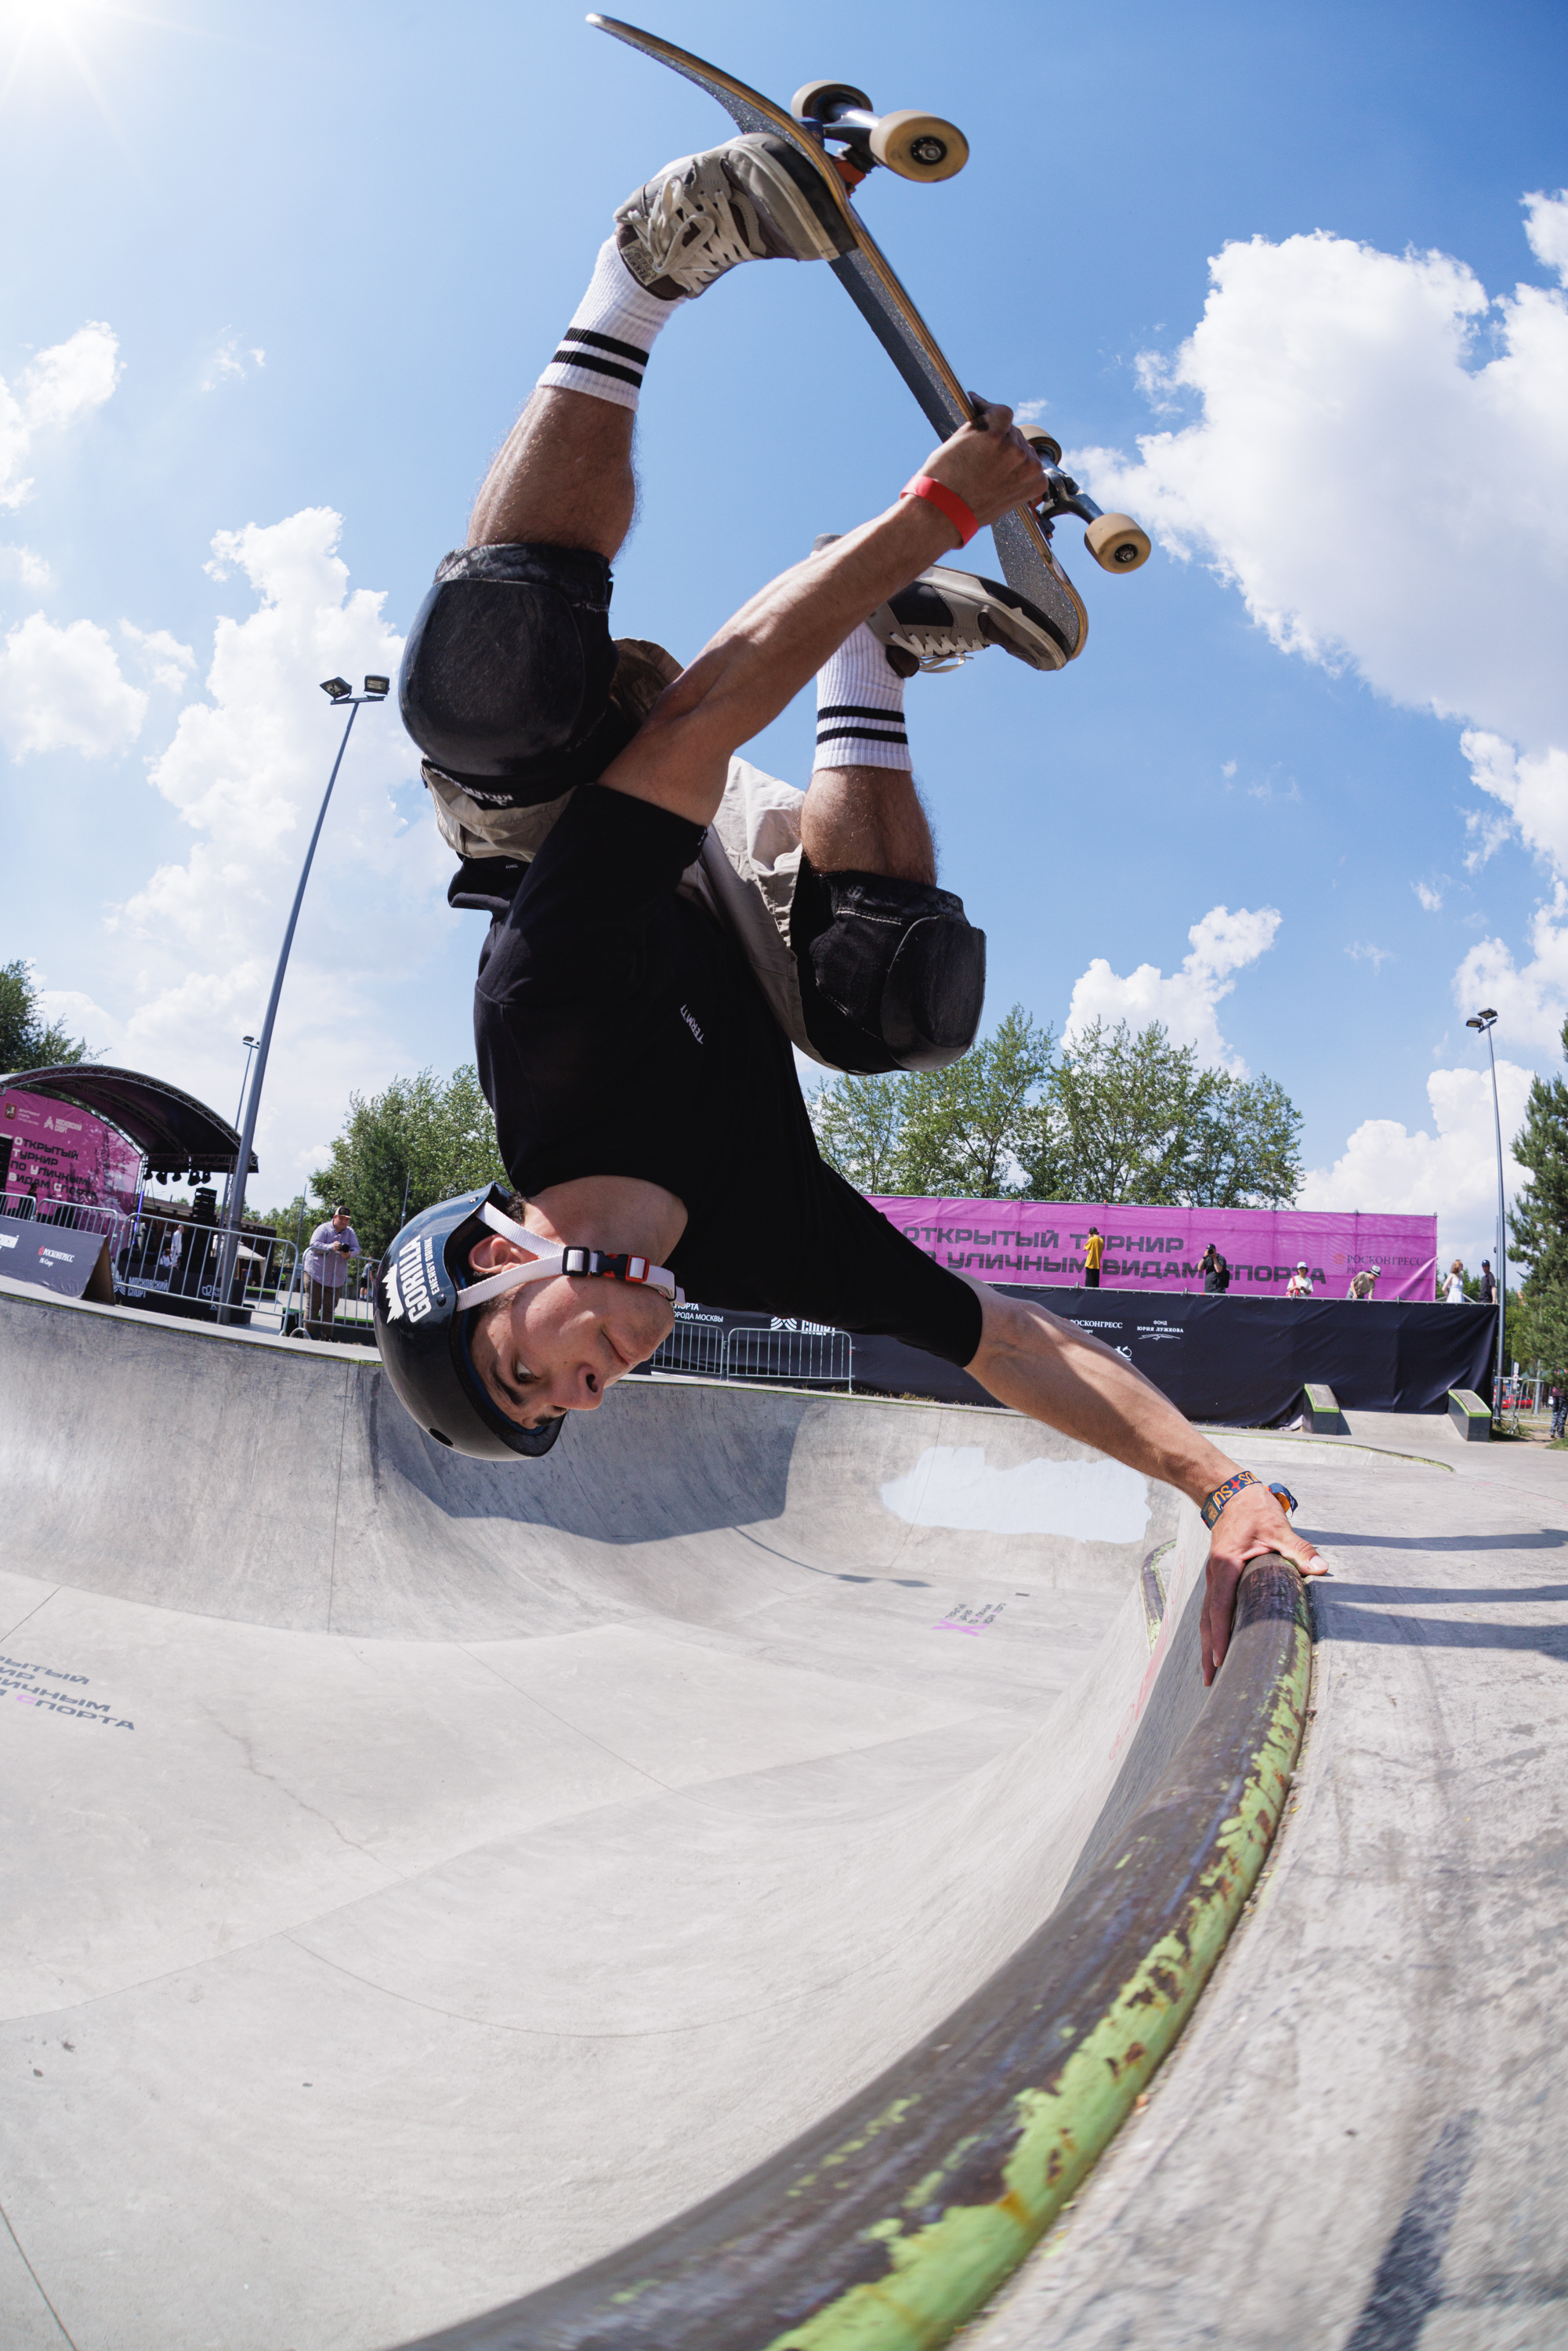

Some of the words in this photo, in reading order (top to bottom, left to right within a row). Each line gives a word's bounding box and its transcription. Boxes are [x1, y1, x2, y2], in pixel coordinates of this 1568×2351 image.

[13, 1148, 58, 1166] ТУРНИР
[14, 1136, 79, 1160] ОТКРЫТЫЙ
[8, 1172, 50, 1189] ВИДАМ
[10, 1161, 27, 1171] ПО
[30, 1165, 88, 1186] УЛИЧНЫМ
[424, 1237, 433, 1262] DRINK
[903, 1226, 1059, 1248] ОТКРЫТЫЙ
[1070, 1233, 1184, 1254] ТРНИР
[947, 1251, 1087, 1274] УЛИЧНЫМ
[1102, 1259, 1204, 1280] ВИДАМ
[1226, 1264, 1327, 1284] ПОРА
[1347, 1255, 1424, 1266] РОСКОНГРЕСС
[129, 1276, 168, 1292] МОСКОВСКИЙ
[399, 1234, 432, 1323] GORILLA
[425, 1261, 440, 1295] ENERGY
[674, 1311, 694, 1320] ОРОДА
[695, 1313, 724, 1323] МОСКВЫ
[1070, 1319, 1123, 1329] РОСКОНГРЕСС
[0, 1678, 111, 1712] ИЧНЫМ
[16, 1694, 135, 1730] СПОРТА
